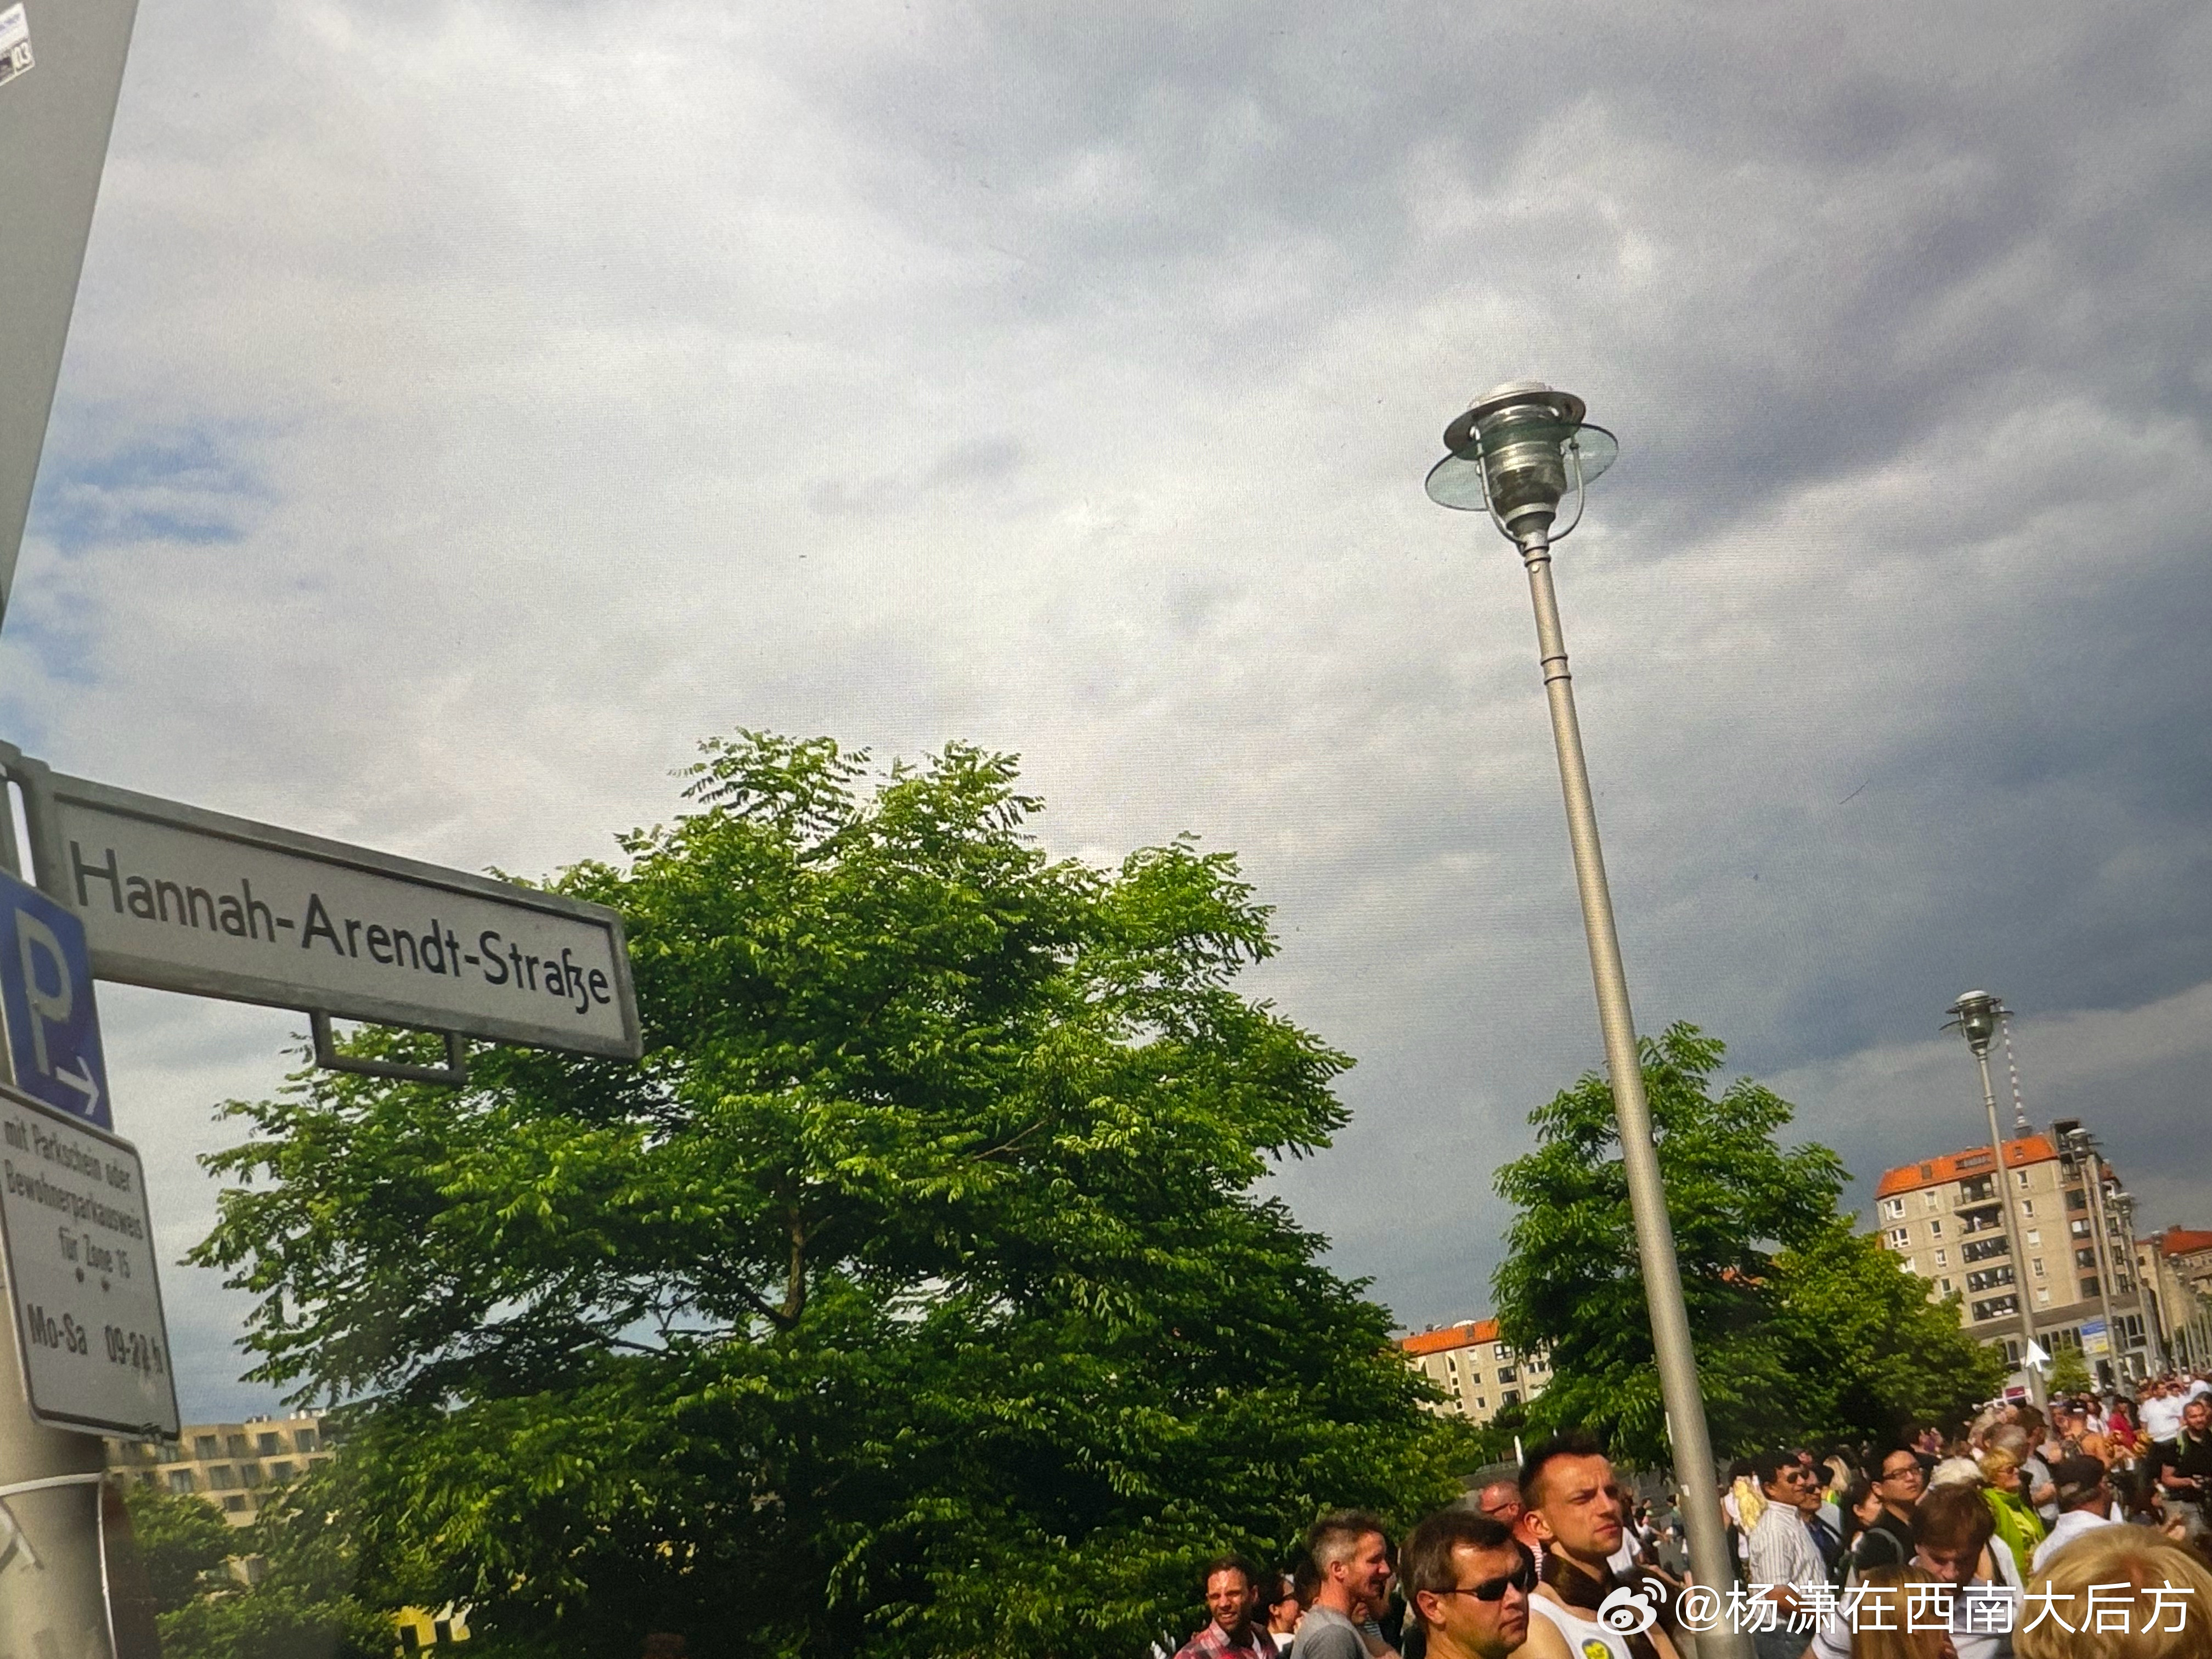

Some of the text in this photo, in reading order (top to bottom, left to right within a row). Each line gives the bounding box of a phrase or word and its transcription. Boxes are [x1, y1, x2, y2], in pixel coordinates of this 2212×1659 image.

[70, 840, 611, 1015] Hannah-Arendt-Straße
[15, 907, 73, 1076] P
[4, 1116, 131, 1192] mit Parkschein oder
[4, 1159, 143, 1240] Bewohnerparkausweis
[58, 1226, 79, 1262] für
[83, 1233, 114, 1273] Zone
[27, 1304, 88, 1356] Mo-Sa
